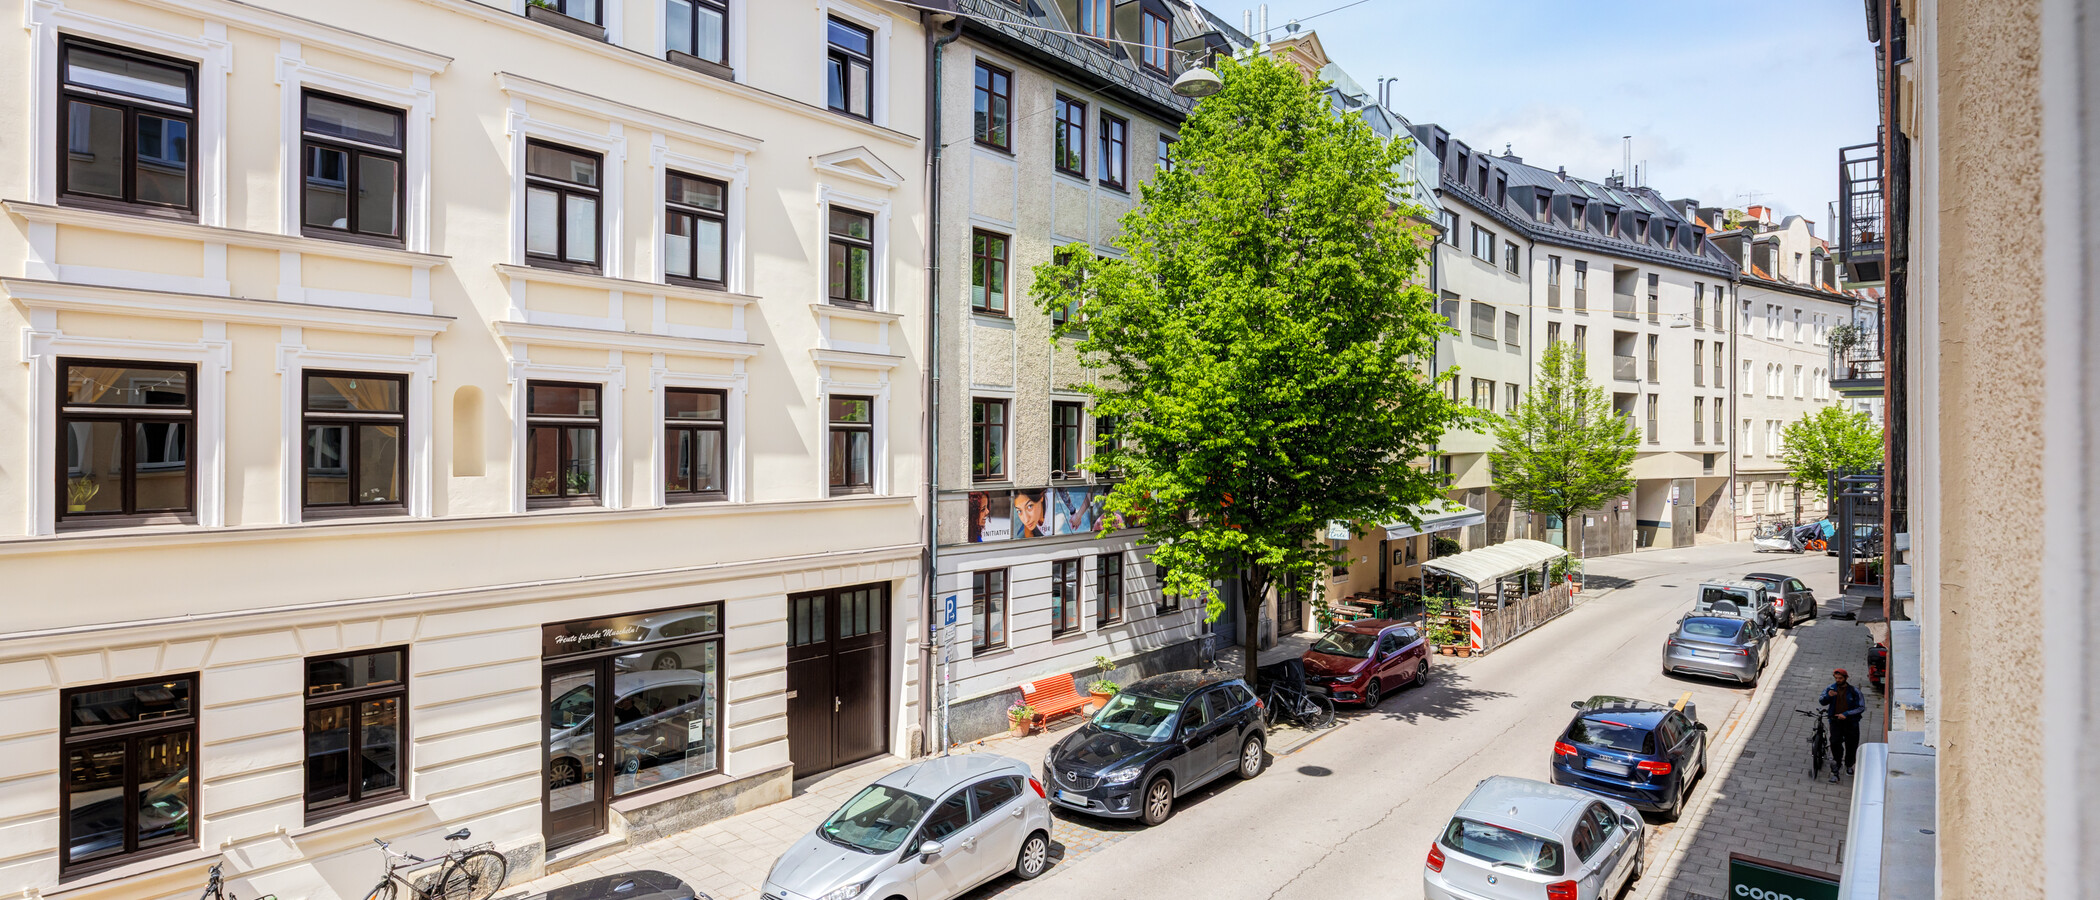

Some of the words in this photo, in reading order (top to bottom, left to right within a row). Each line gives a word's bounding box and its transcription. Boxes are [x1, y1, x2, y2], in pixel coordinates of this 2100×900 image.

[983, 528, 1010, 538] INITIATIVE
[946, 599, 954, 622] P
[554, 634, 577, 645] Heute
[577, 629, 601, 644] frische
[602, 624, 641, 637] Muscheln!
